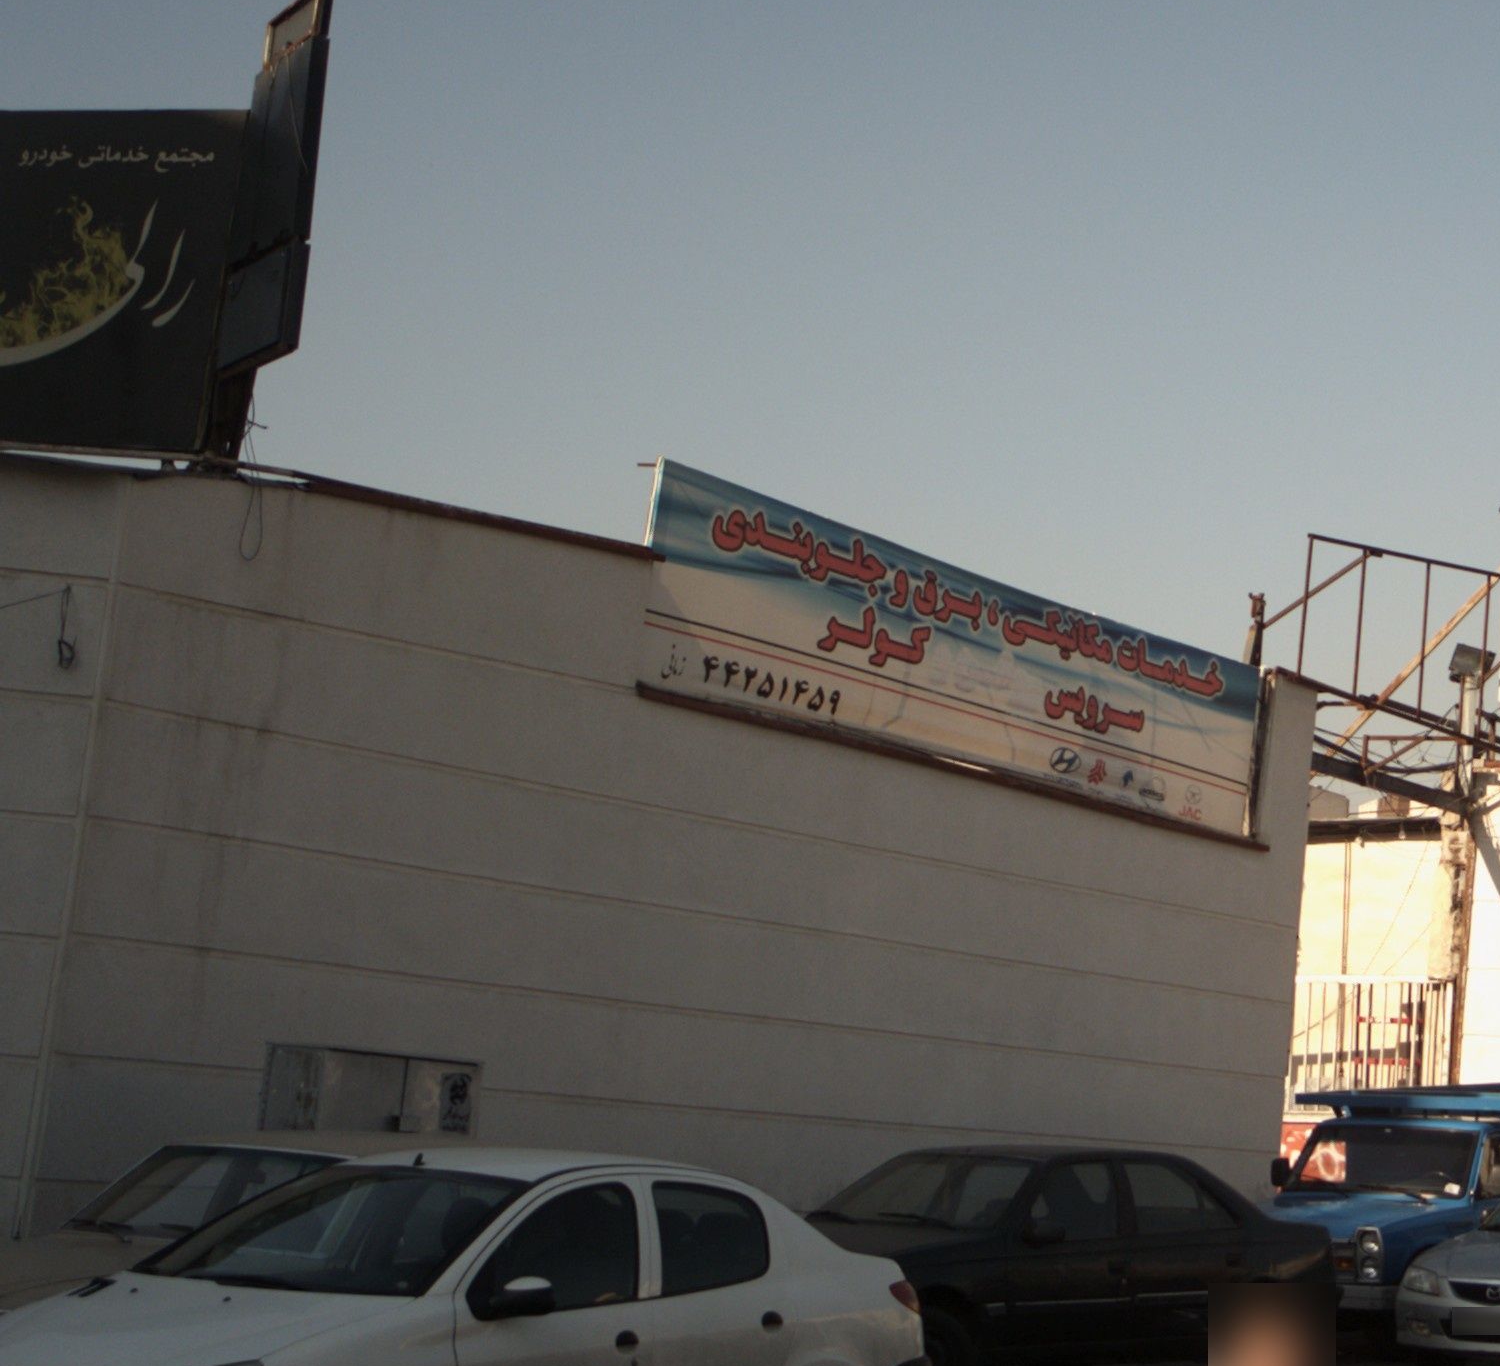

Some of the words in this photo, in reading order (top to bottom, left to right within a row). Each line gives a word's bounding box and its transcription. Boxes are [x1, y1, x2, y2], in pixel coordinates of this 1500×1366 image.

[19, 145, 73, 167] خودرو
[78, 146, 150, 169] خدماتی
[155, 147, 215, 173] مجتمع
[712, 509, 887, 597] جلوبندی
[889, 569, 909, 609] و
[913, 569, 982, 632] برق
[817, 606, 931, 667] کولر
[702, 655, 841, 716] ۴۴۲۵۱۴۵۹
[1116, 636, 1224, 697] خدمات
[1044, 685, 1145, 735] سرویس
[1178, 804, 1203, 821] JAC
